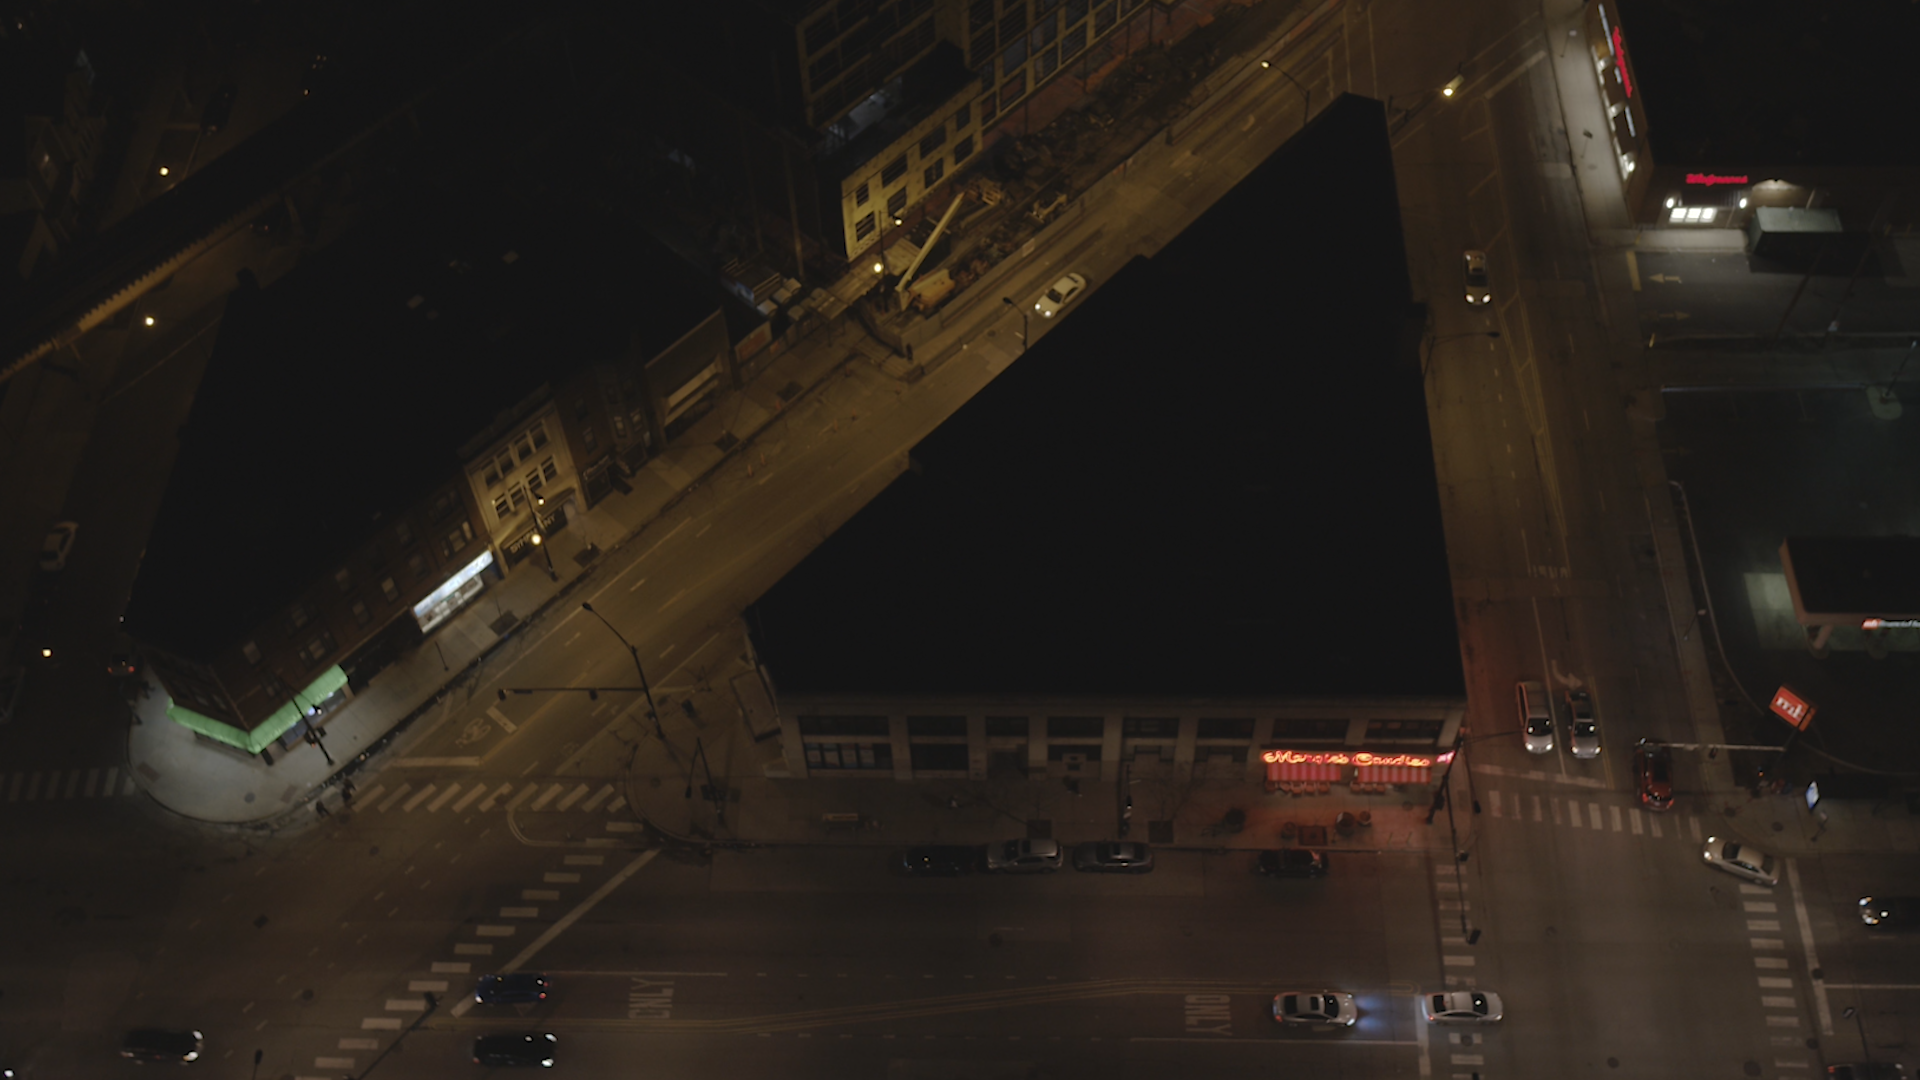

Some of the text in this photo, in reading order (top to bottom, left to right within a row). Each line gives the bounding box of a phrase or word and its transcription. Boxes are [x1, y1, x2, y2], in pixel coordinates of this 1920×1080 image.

[1352, 753, 1430, 766] Candies
[628, 977, 674, 1018] ONLY
[1184, 994, 1233, 1036] ONLY
